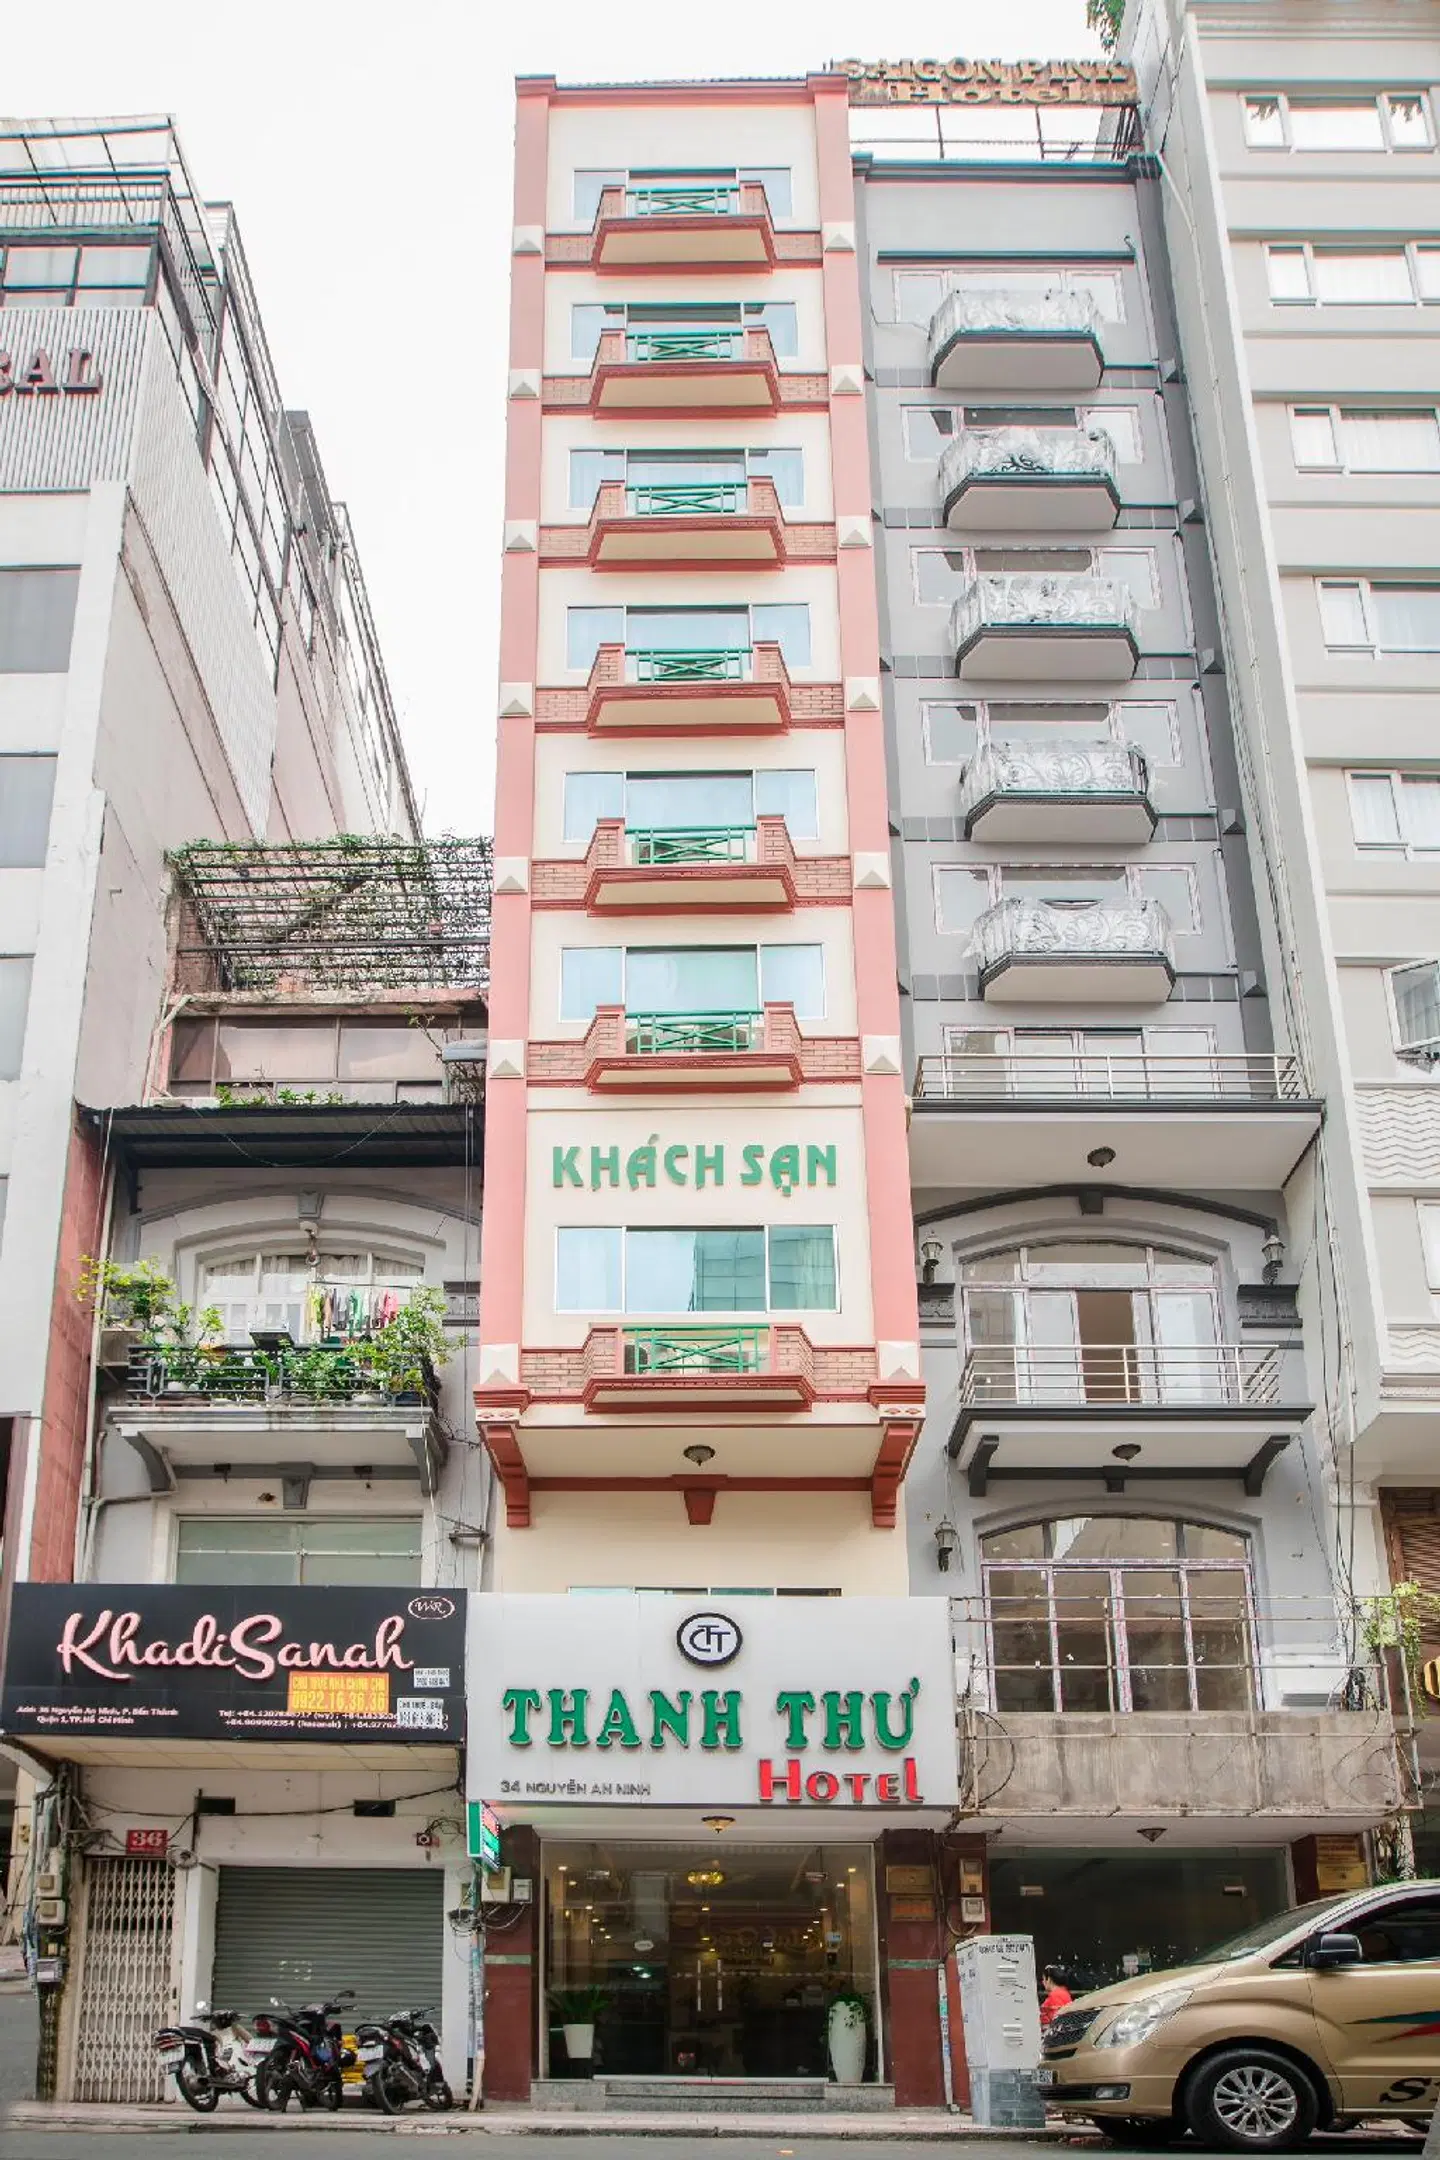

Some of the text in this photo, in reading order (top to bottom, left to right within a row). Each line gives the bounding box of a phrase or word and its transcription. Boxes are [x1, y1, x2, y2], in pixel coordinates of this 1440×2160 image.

[843, 57, 1127, 83] SAIGON PINK
[552, 1133, 837, 1197] KHÁCH SẠN
[57, 1609, 415, 1680] KhadiSanah
[502, 1676, 922, 1751] THANH THƯ
[500, 1778, 651, 1797] 34 NGUYỄN AN NINH
[132, 1831, 163, 1847] 36
